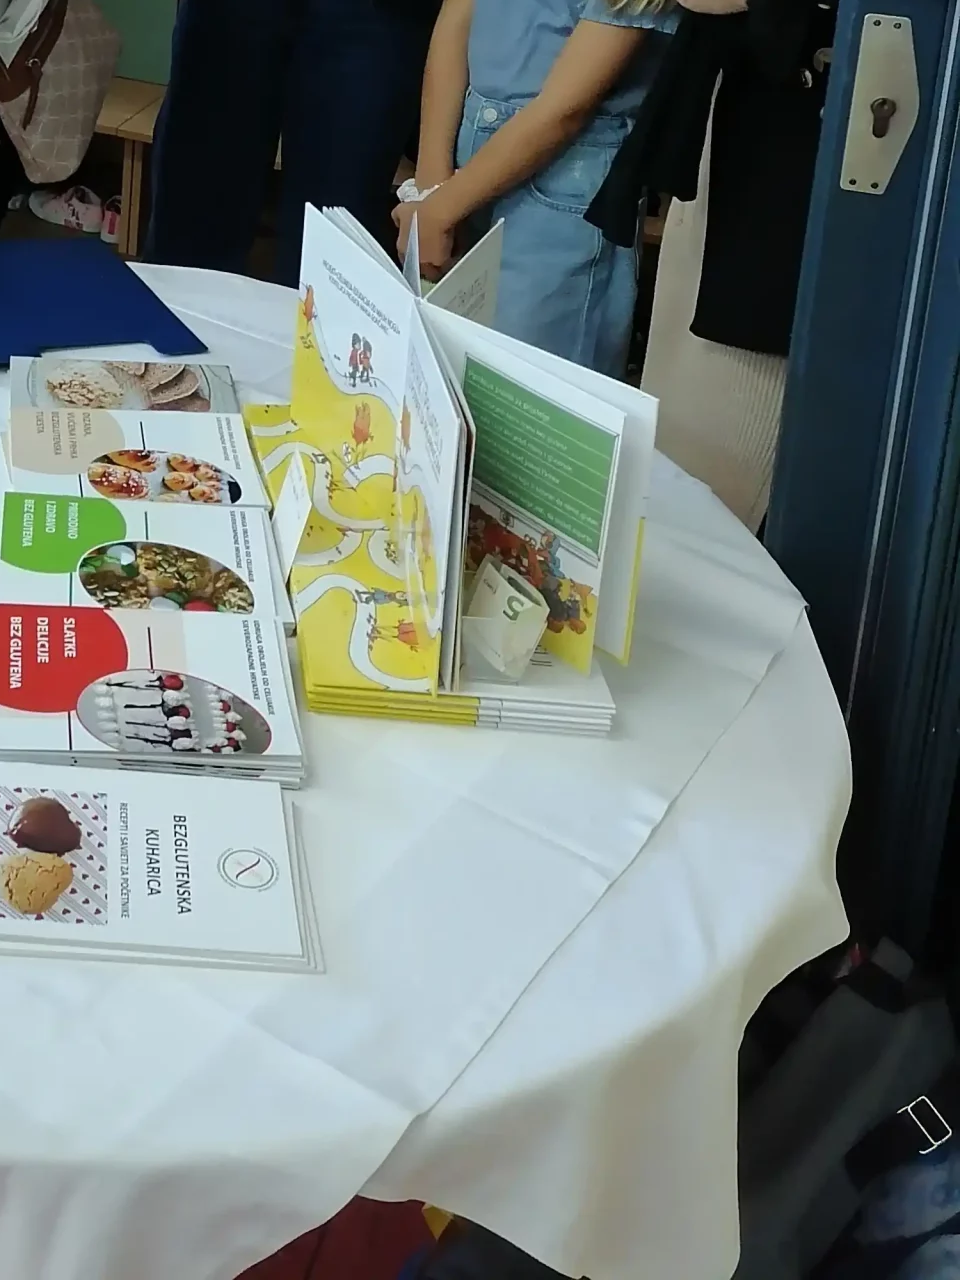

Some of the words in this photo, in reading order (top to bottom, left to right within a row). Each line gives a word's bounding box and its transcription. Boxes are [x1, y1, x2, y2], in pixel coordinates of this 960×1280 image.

[51, 412, 61, 455] BEZGLUTENSKA
[23, 499, 35, 514] BEZ
[45, 504, 57, 533] ZDRAVO
[67, 502, 79, 539] PRIRODNO
[21, 514, 35, 547] GLUTENA
[9, 616, 22, 638] BEZ
[36, 616, 50, 664] DELICIJE
[63, 617, 77, 658] SLATKE
[253, 619, 265, 644] UDRUGA
[8, 638, 22, 689] GLUTENA
[240, 619, 255, 670] SJEVEROZAPADNE
[249, 671, 261, 700] HRVATSKE
[255, 645, 269, 676] OBOLJELIH
[260, 677, 270, 687] OD
[120, 802, 130, 831] RECEPTI
[120, 836, 130, 865] SAVJETI
[145, 828, 162, 897] KUHARICA
[173, 814, 192, 915] BEZGLUTENSKA
[120, 866, 130, 876] ZA
[120, 877, 132, 919] POČETNIKE
